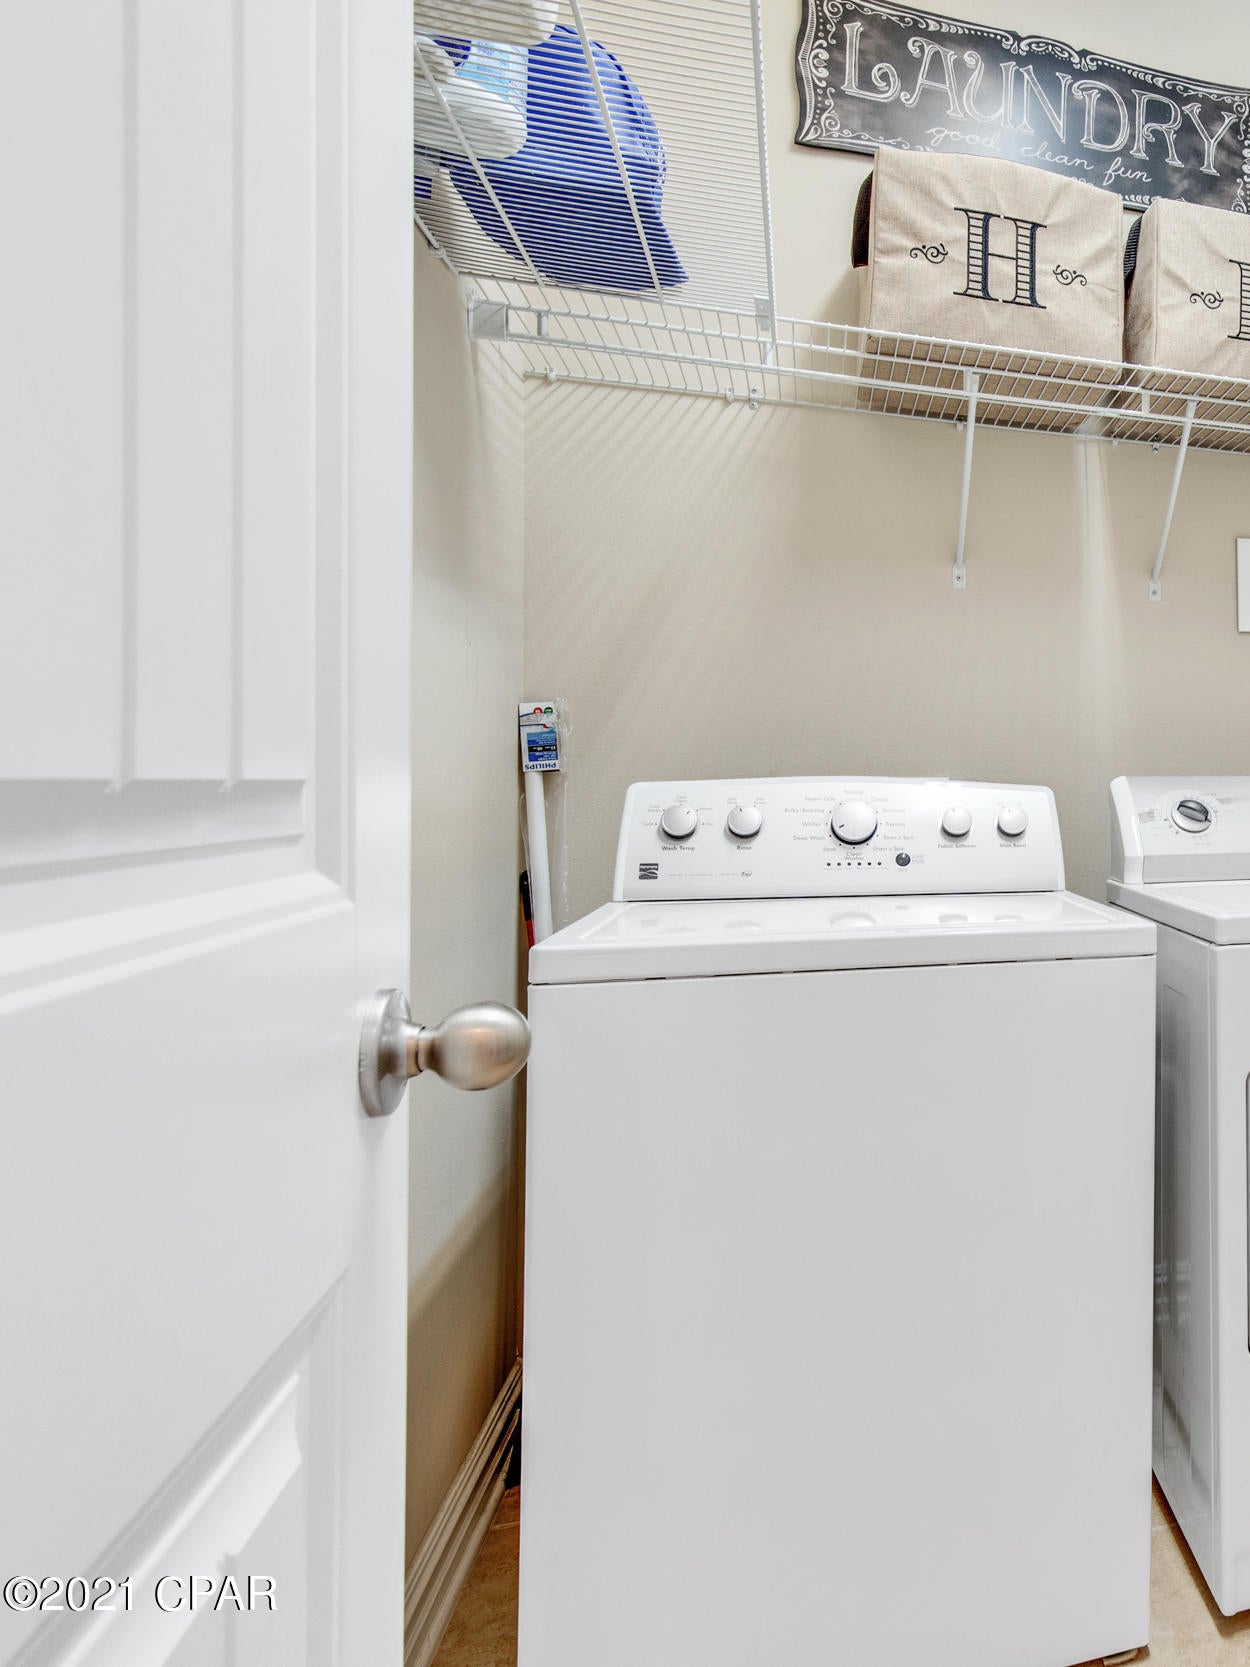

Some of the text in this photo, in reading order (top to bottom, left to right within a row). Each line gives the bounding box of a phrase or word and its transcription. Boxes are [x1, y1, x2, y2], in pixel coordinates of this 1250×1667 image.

[842, 21, 1240, 177] LAUNDRY
[925, 126, 1154, 185] good clean fun
[952, 205, 1048, 309] H
[524, 762, 557, 771] PHILIPS
